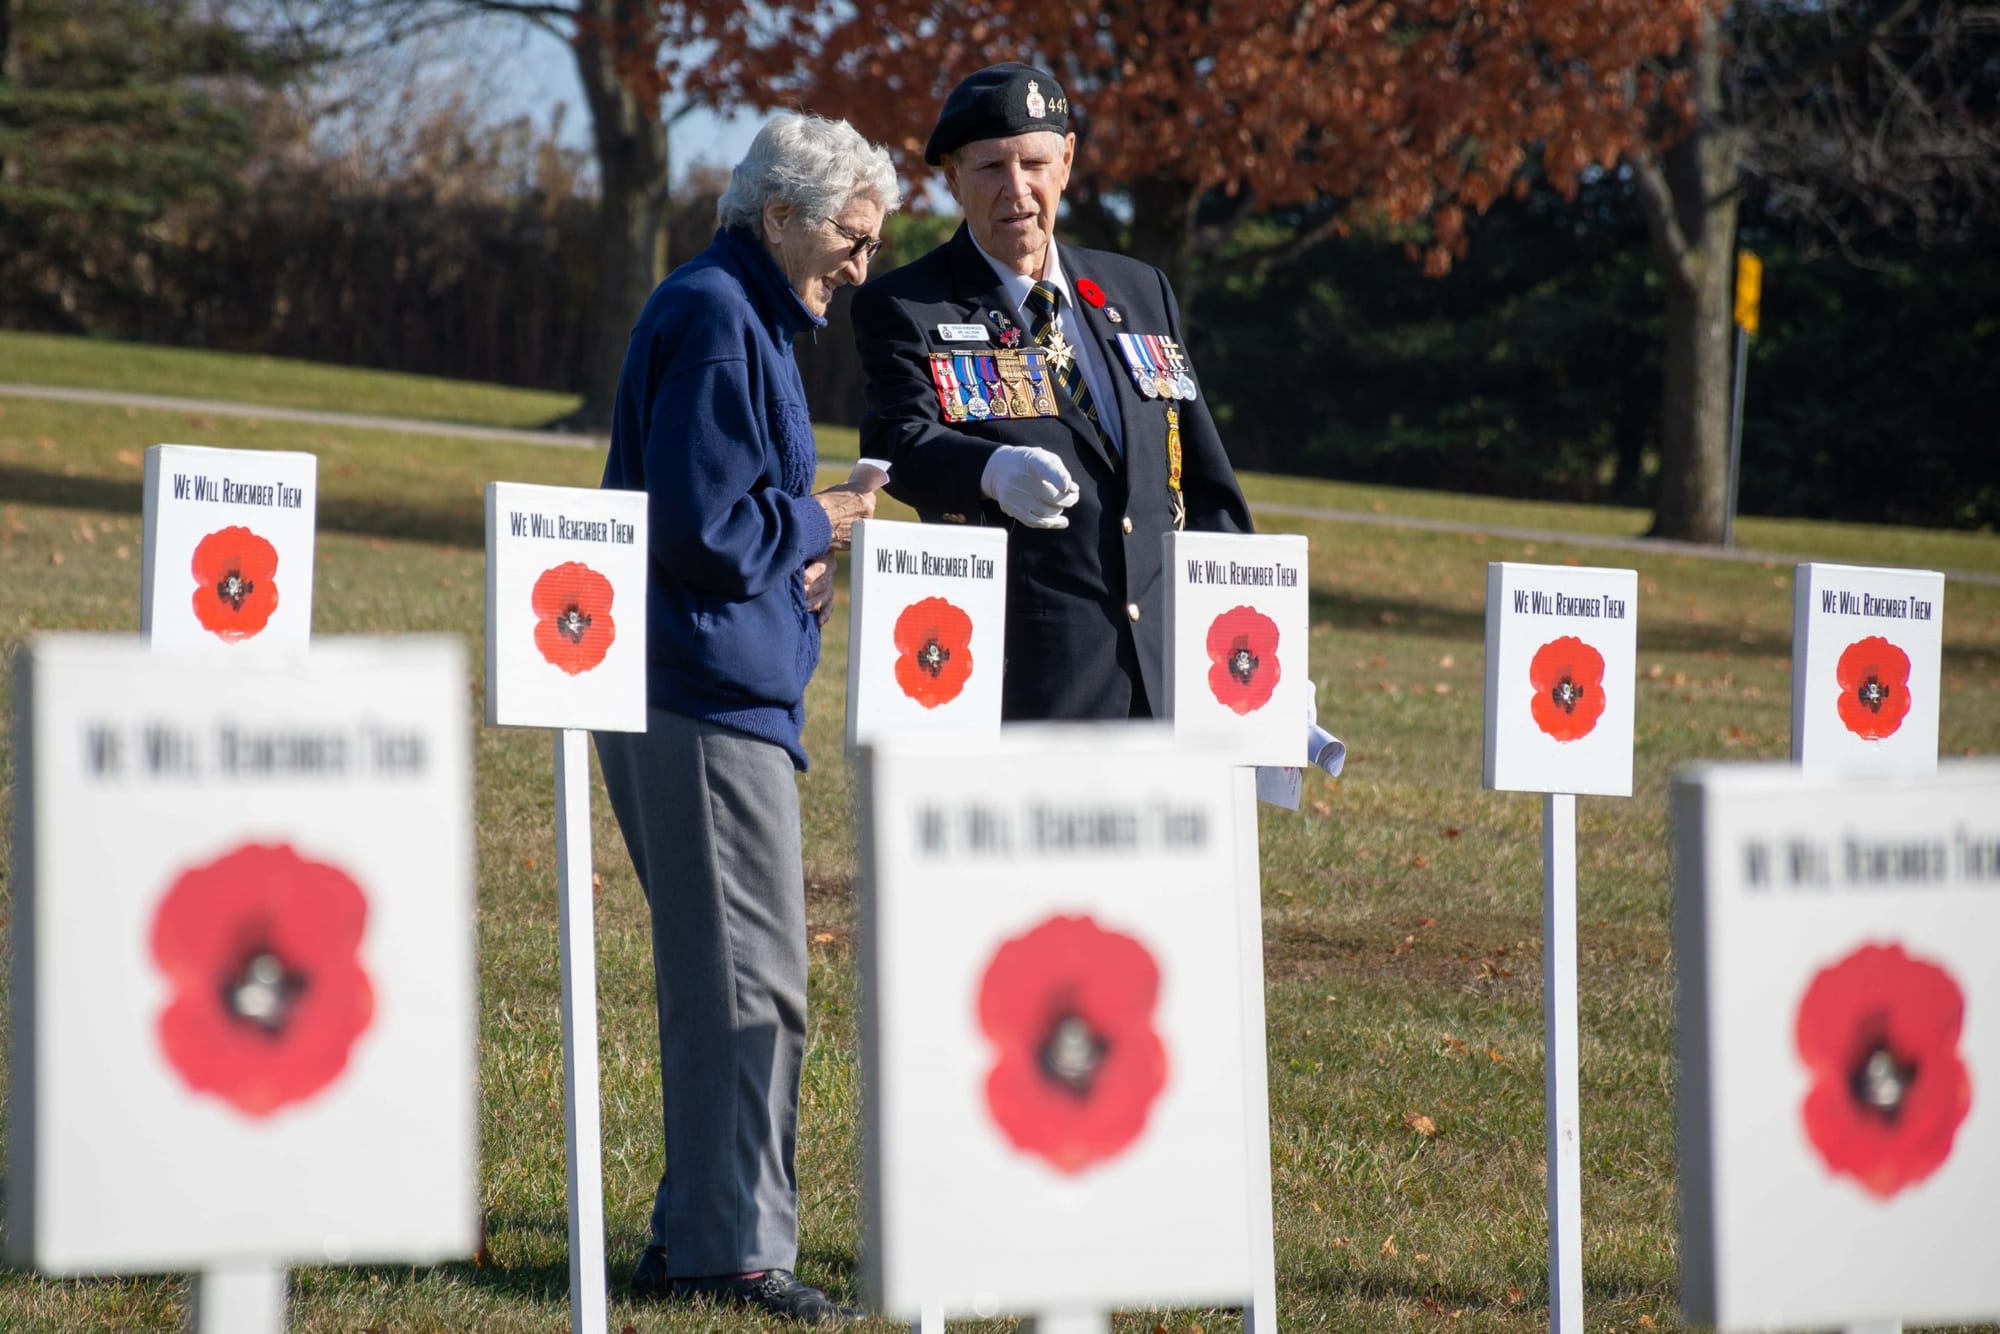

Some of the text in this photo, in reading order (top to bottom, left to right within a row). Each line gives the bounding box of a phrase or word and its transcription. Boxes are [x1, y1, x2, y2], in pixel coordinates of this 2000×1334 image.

[174, 473, 302, 509] We Will Remember Them
[510, 511, 634, 544] We Will Remember Them
[877, 548, 994, 580] We Will Remember Them
[1187, 559, 1297, 587] We Will Remember Them
[1514, 589, 1625, 619] We Will Remember Them
[1822, 589, 1931, 620] We Will Remember Them
